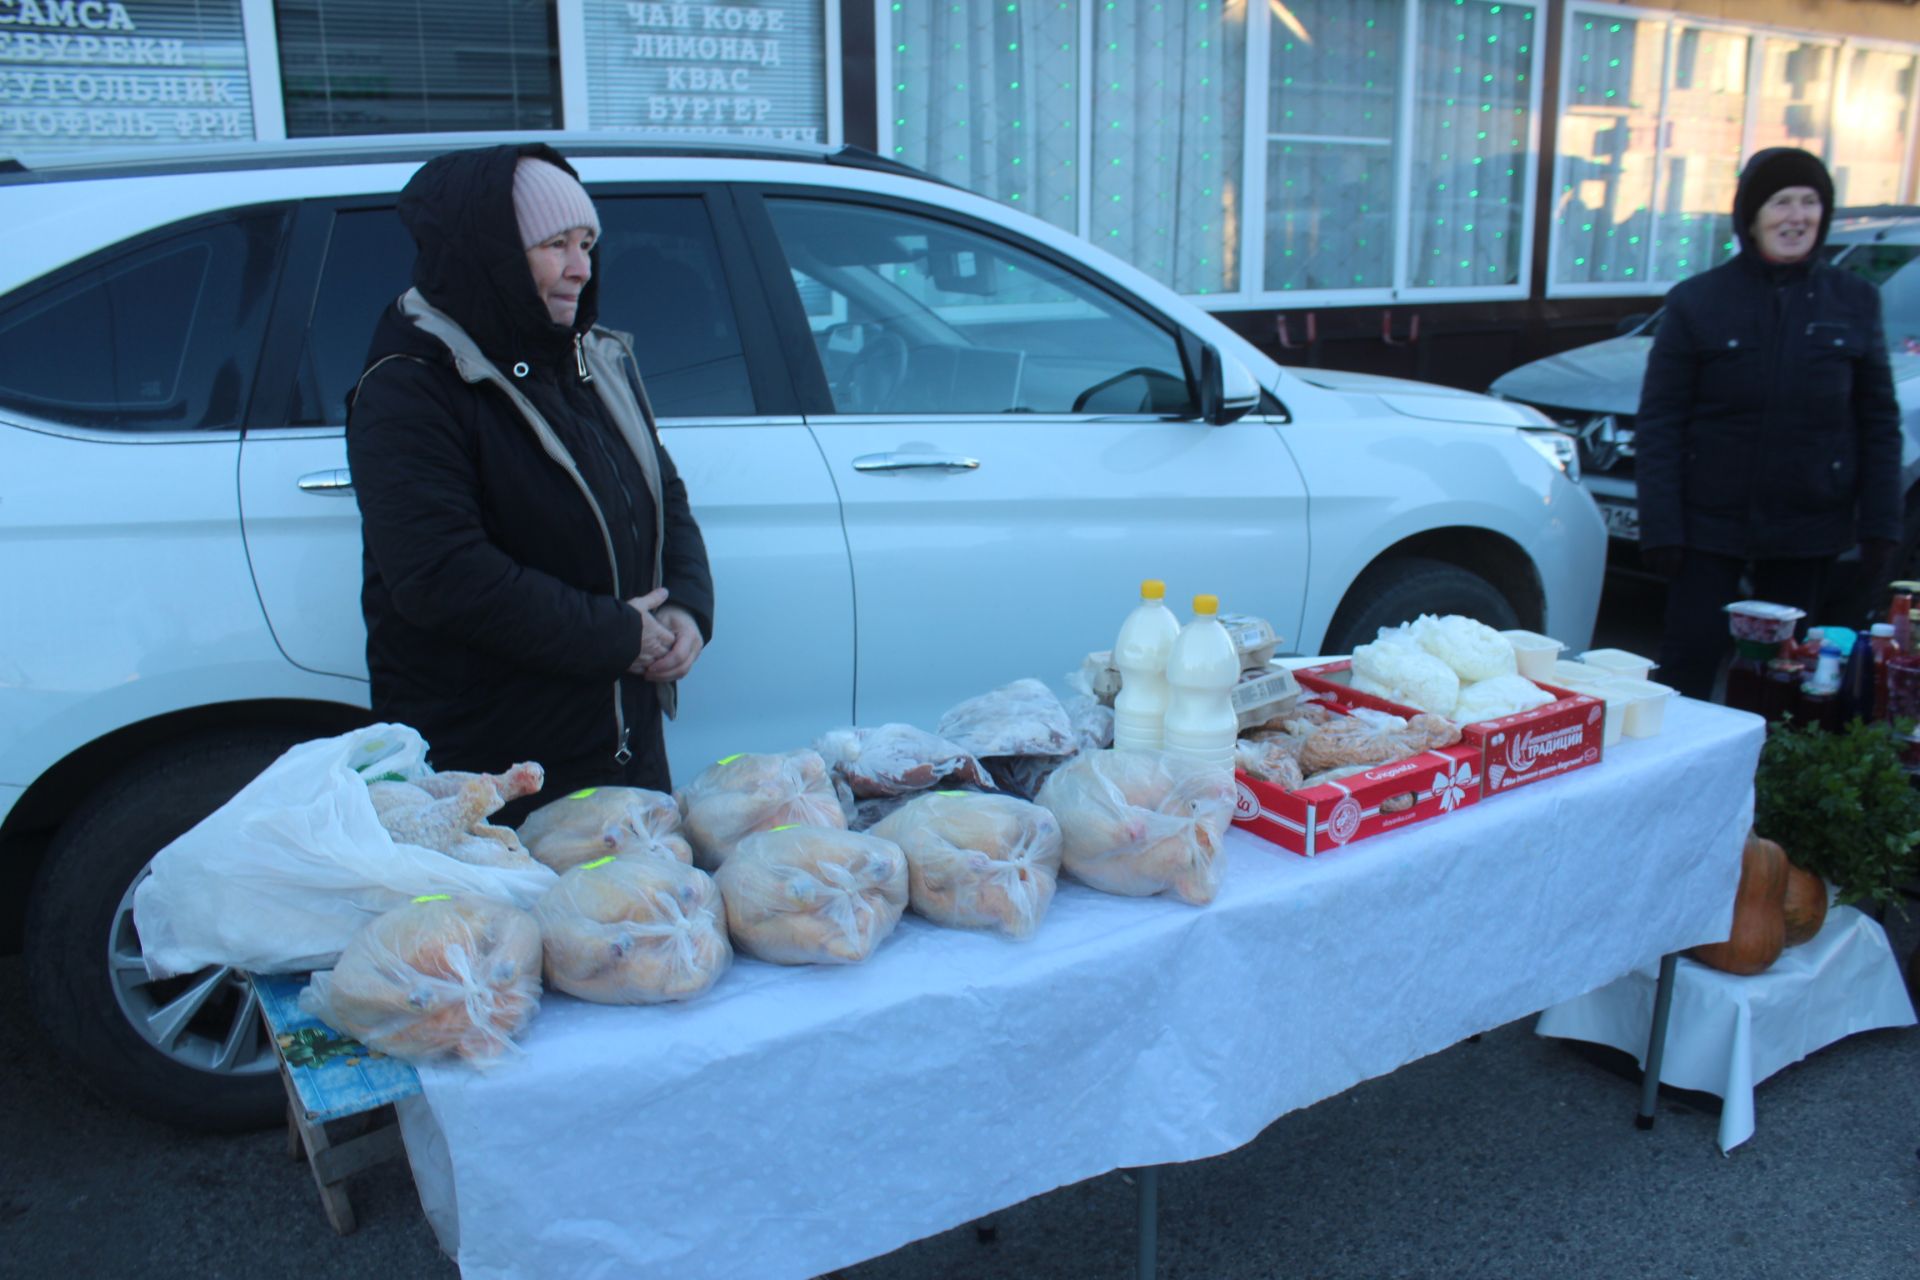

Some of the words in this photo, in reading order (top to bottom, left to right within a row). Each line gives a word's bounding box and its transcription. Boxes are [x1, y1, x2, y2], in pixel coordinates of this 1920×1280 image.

[0, 0, 136, 30] САМСА
[703, 6, 784, 31] КОФЕ
[631, 35, 780, 66] ЛИМОНАД
[666, 66, 749, 91] КВАС
[649, 95, 772, 120] БУРГЕР
[174, 110, 242, 136] ФРИ
[1527, 731, 1583, 758] ТРАДИЦИИ
